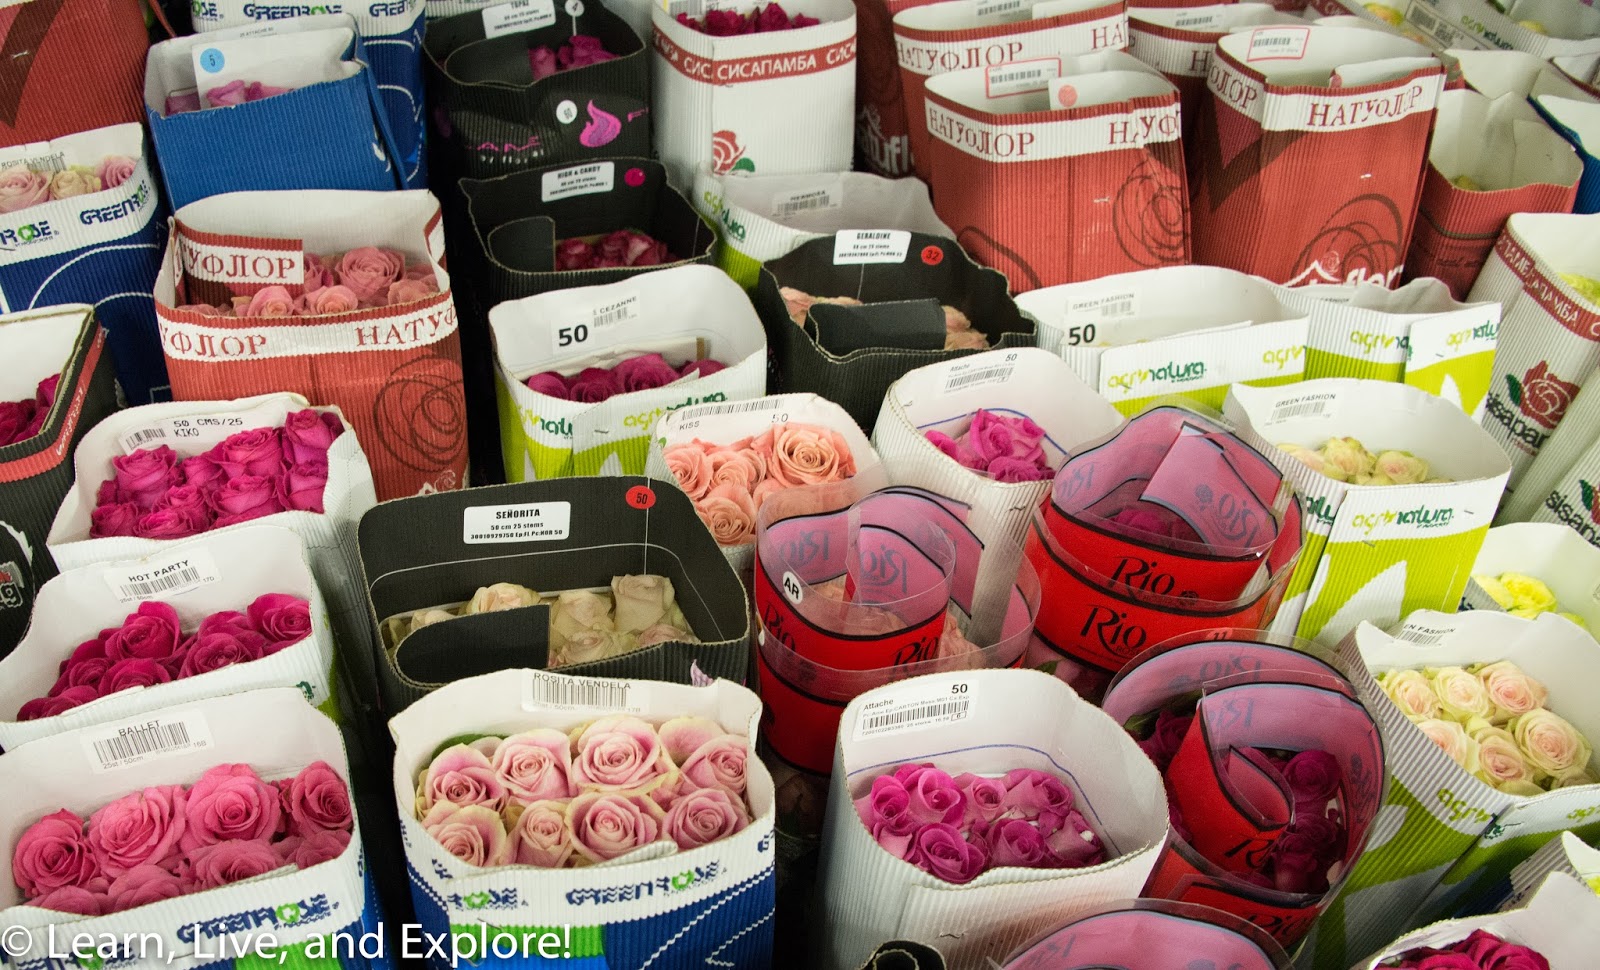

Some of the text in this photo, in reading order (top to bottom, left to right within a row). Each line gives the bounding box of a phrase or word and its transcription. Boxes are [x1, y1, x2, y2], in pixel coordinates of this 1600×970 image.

[208, 54, 217, 67] 5
[717, 54, 817, 80] СИСАПАМБА
[926, 249, 940, 261] 32
[600, 296, 637, 314] CEZANNE
[1073, 293, 1135, 310] GREEN FASHION
[558, 324, 589, 347] 50
[1068, 323, 1096, 346] 50
[1005, 353, 1018, 362] 50
[1275, 393, 1337, 408] GREEN FASHION
[173, 418, 243, 428] 50 CMS/25
[679, 420, 700, 431] KISS
[174, 428, 200, 437] KIKO
[635, 493, 648, 504] 50
[495, 508, 541, 520] SEÑORITA
[128, 560, 189, 583] HOT PARTY
[1107, 556, 1176, 601] Rio
[783, 577, 800, 600] AR
[1080, 604, 1147, 659] Rio
[534, 672, 632, 689] ROSITA VENDELA
[951, 683, 968, 694] 50
[863, 698, 894, 711] Attache
[118, 720, 160, 737] BALLET
